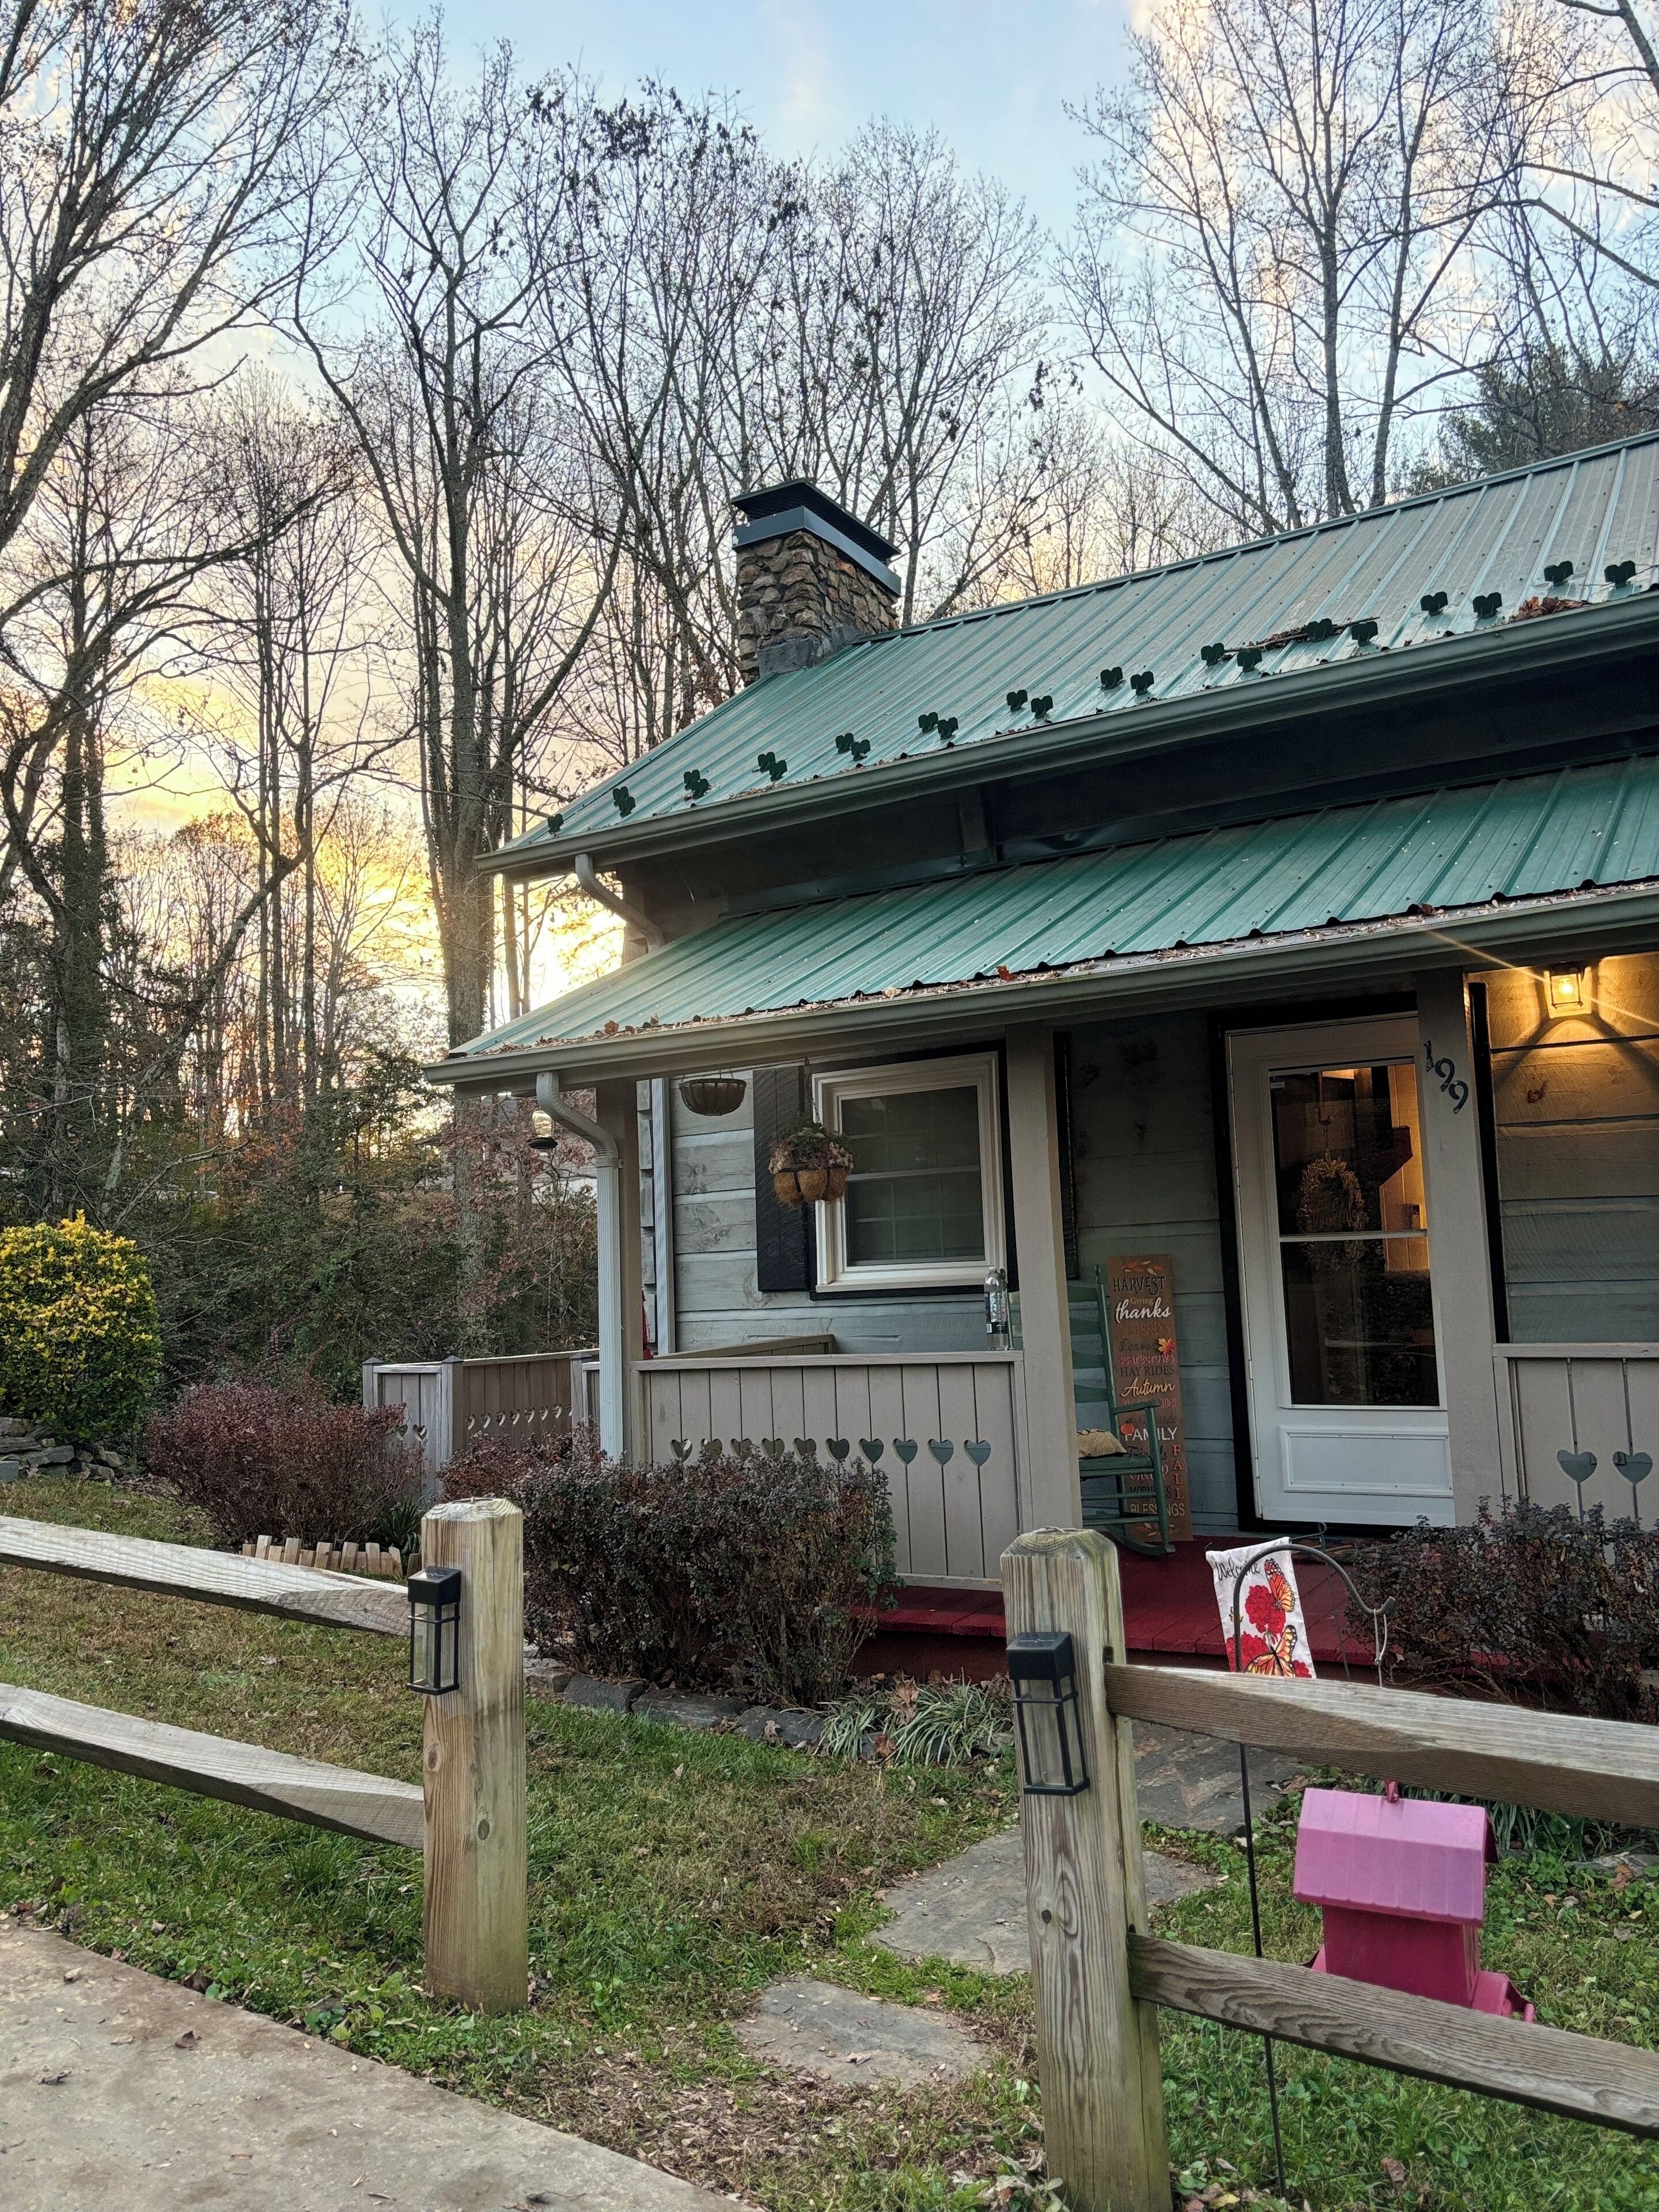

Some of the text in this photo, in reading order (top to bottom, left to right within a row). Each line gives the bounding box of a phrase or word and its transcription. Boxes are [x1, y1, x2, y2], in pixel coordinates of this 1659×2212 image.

[1424, 1040, 1468, 1114] 199
[1113, 1277, 1166, 1296] HARVEST
[1115, 1297, 1172, 1323] thanks
[1130, 1297, 1154, 1305] Giving
[1120, 1365, 1175, 1377] HAY RIDES
[1120, 1377, 1176, 1397] Autumn
[1172, 1445, 1185, 1499] FALL
[1130, 1503, 1185, 1516] BLESNGS
[1215, 1556, 1261, 1581] Welce
